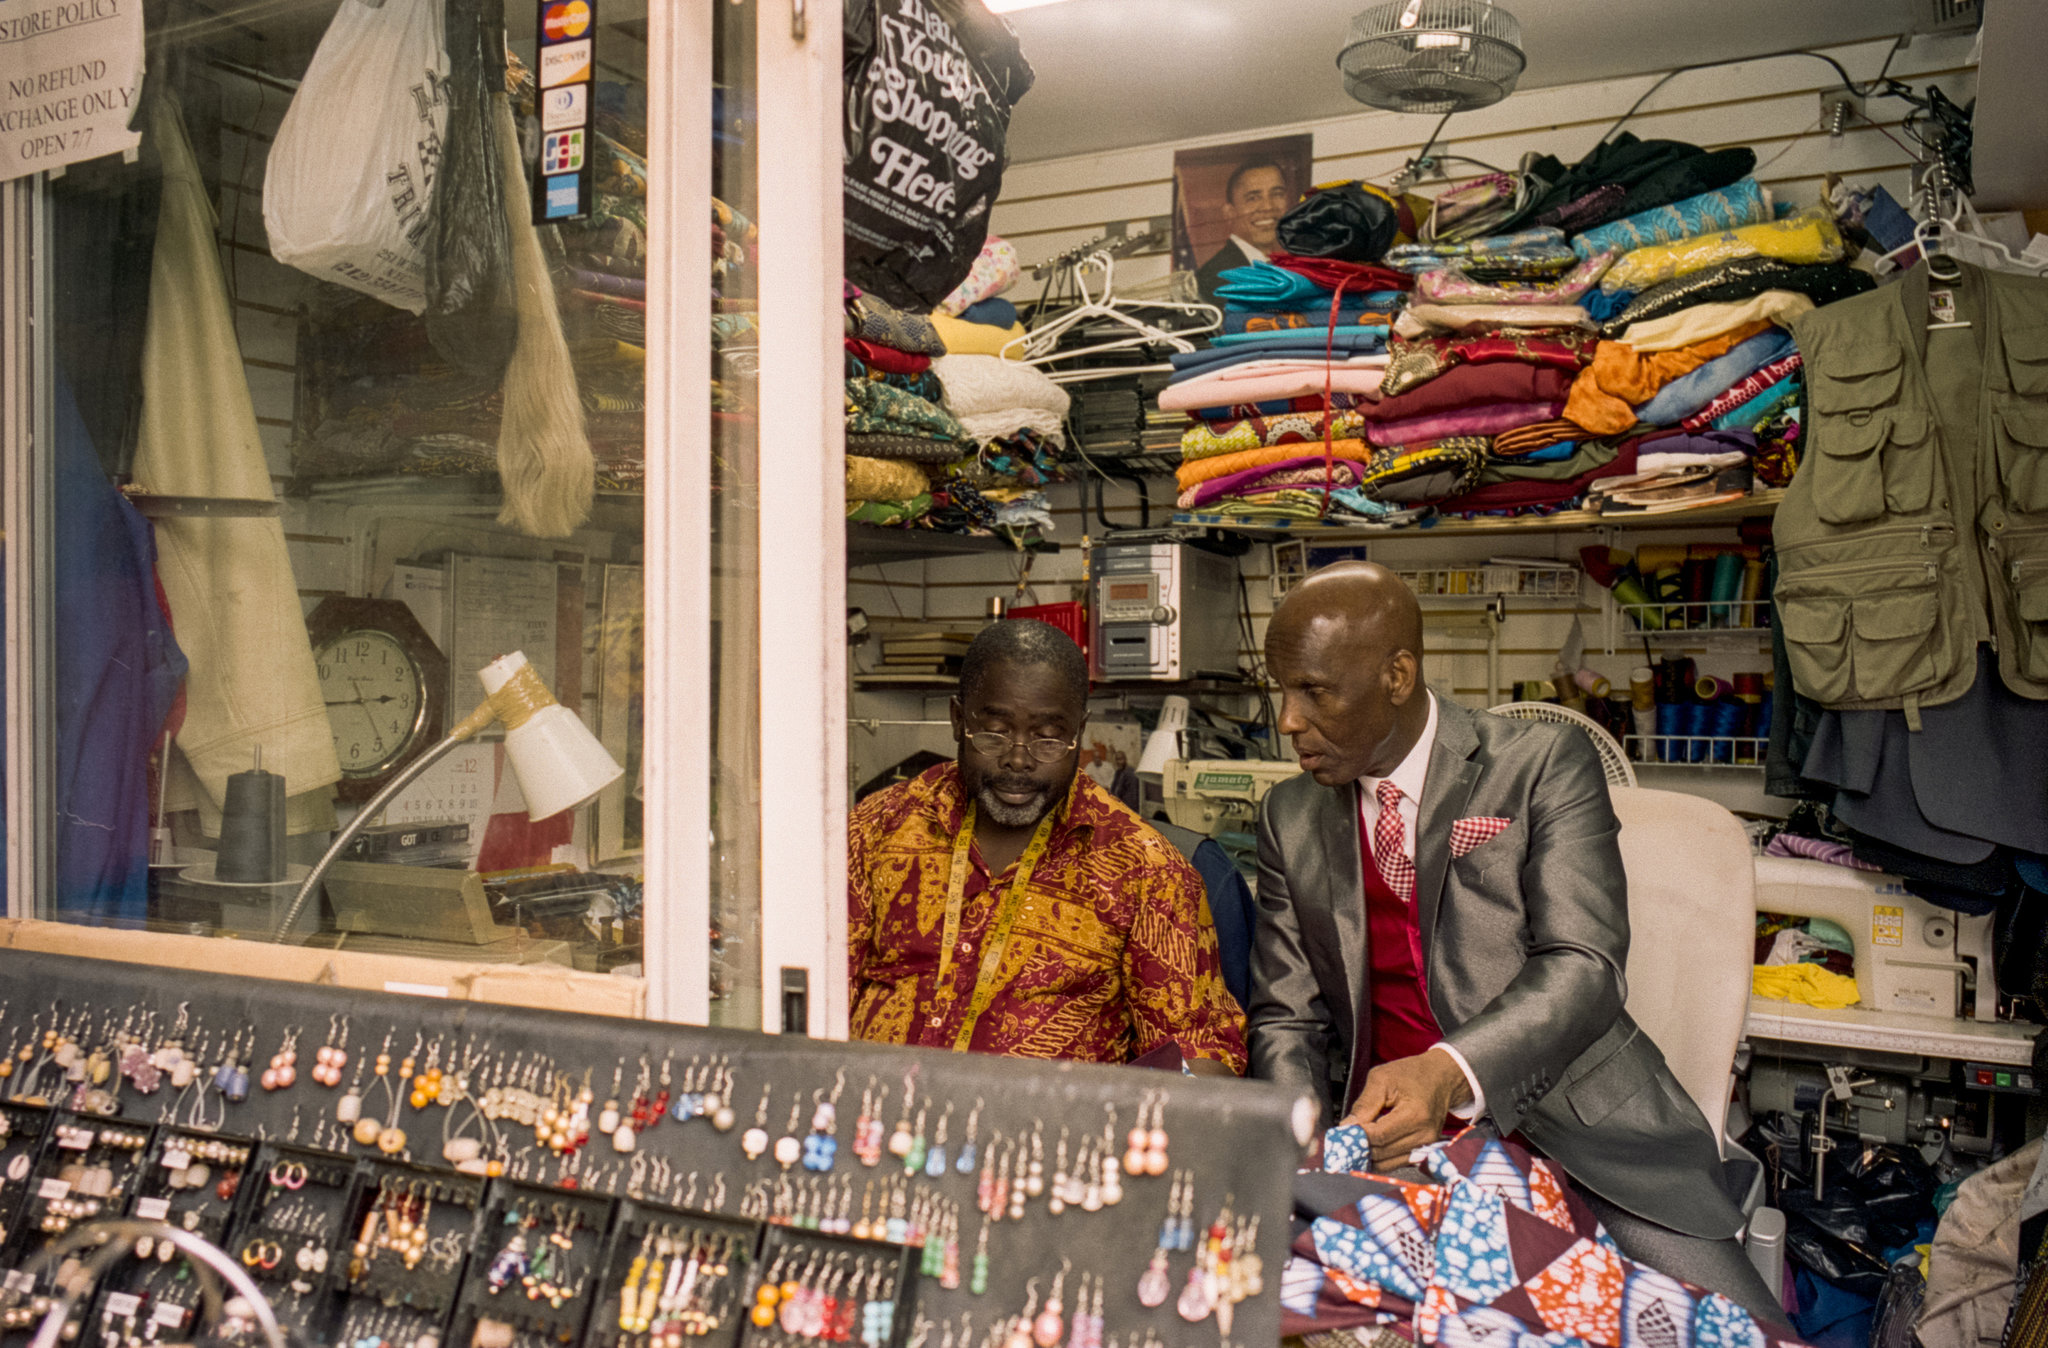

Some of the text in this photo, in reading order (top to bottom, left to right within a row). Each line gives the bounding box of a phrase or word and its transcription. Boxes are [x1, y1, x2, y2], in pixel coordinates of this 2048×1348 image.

[0, 0, 119, 40] STORE POLICY
[545, 50, 586, 67] DISCOVER
[9, 60, 106, 100] NO REFUND
[82, 87, 135, 115] ONLY
[21, 131, 67, 160] OPEN
[871, 136, 956, 218] Here.
[335, 647, 348, 664] 11
[355, 641, 370, 657] 12
[381, 650, 387, 665] 1
[395, 667, 404, 682] 2
[399, 693, 409, 709] 3
[390, 720, 399, 734] 4
[350, 743, 360, 759] 6
[372, 737, 383, 752] 5
[465, 759, 478, 774] 12
[415, 800, 421, 810] 5
[425, 801, 433, 810] 6
[401, 834, 417, 847] GOT
